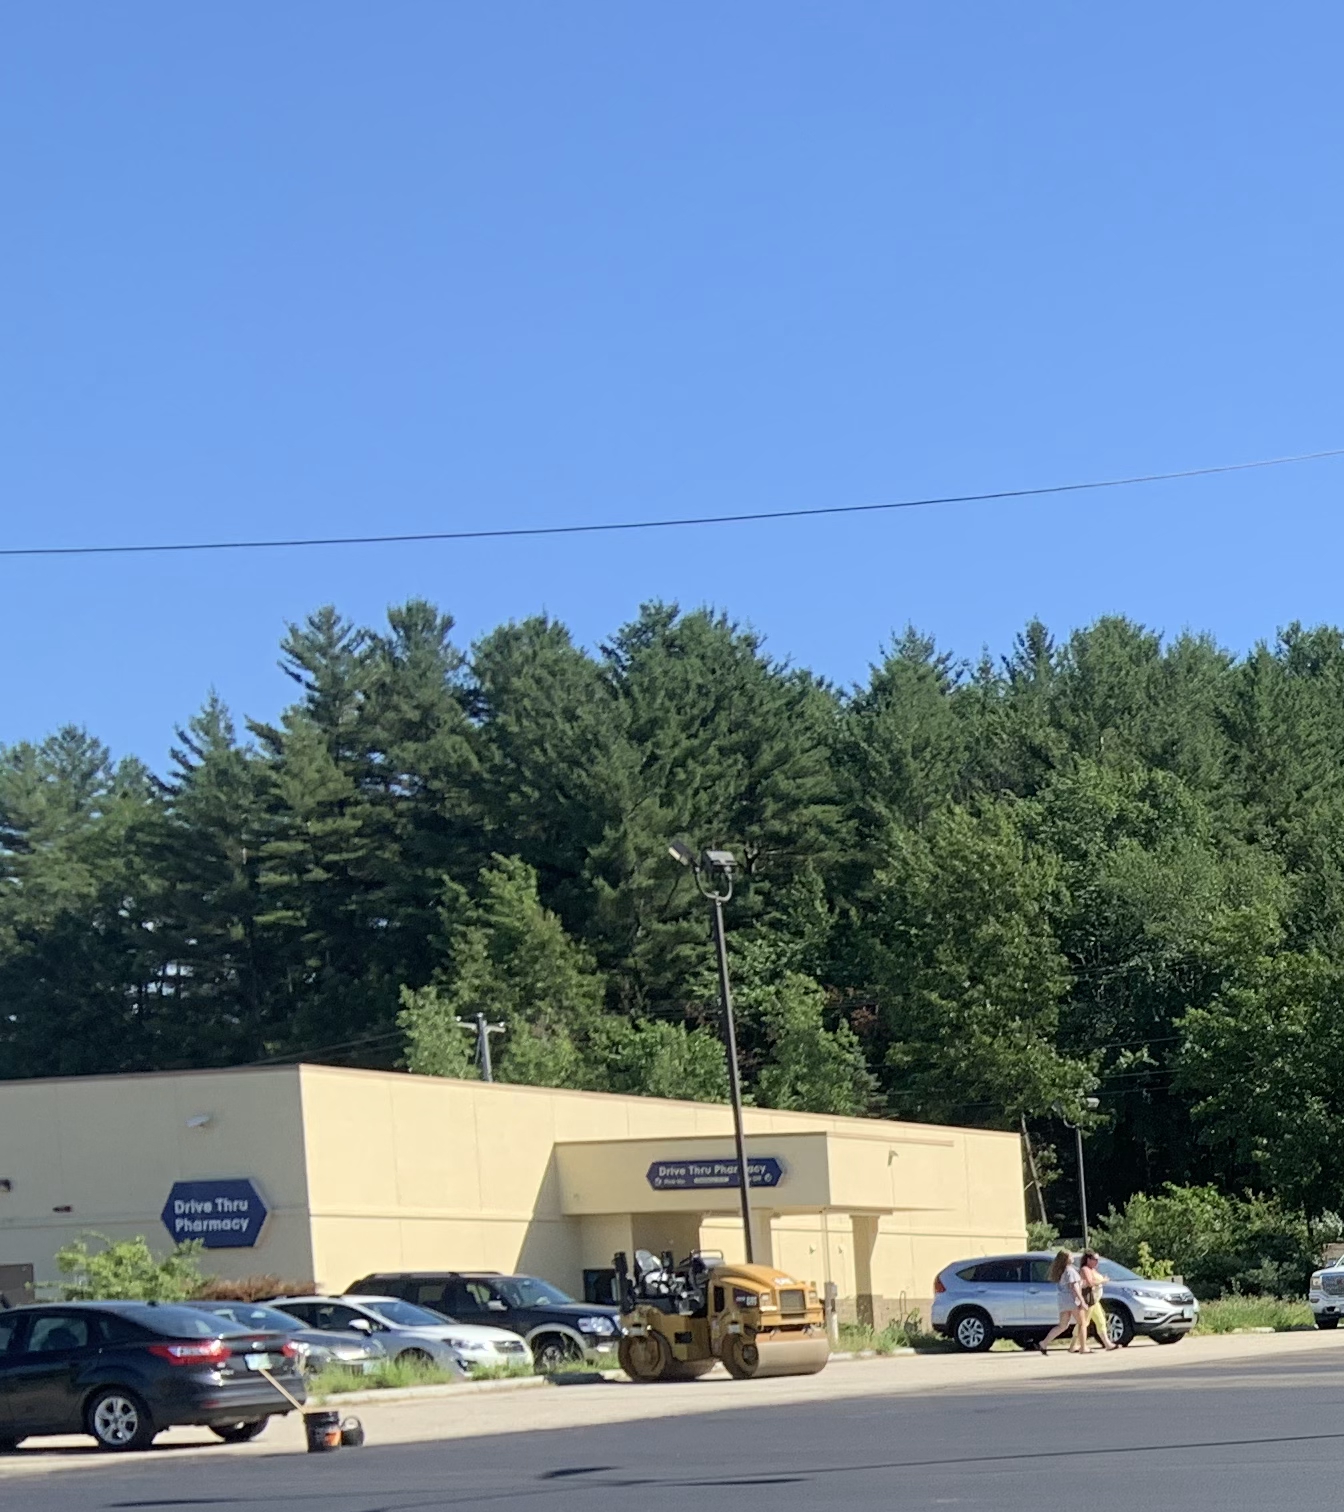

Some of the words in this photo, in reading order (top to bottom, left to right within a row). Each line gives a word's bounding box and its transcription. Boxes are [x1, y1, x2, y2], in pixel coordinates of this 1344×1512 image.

[658, 1166, 686, 1178] Drive
[688, 1165, 712, 1176] Thru
[714, 1163, 767, 1175] Pharacy
[174, 1199, 213, 1215] Drive
[215, 1197, 249, 1213] Thru
[175, 1217, 250, 1233] Pharmacy
